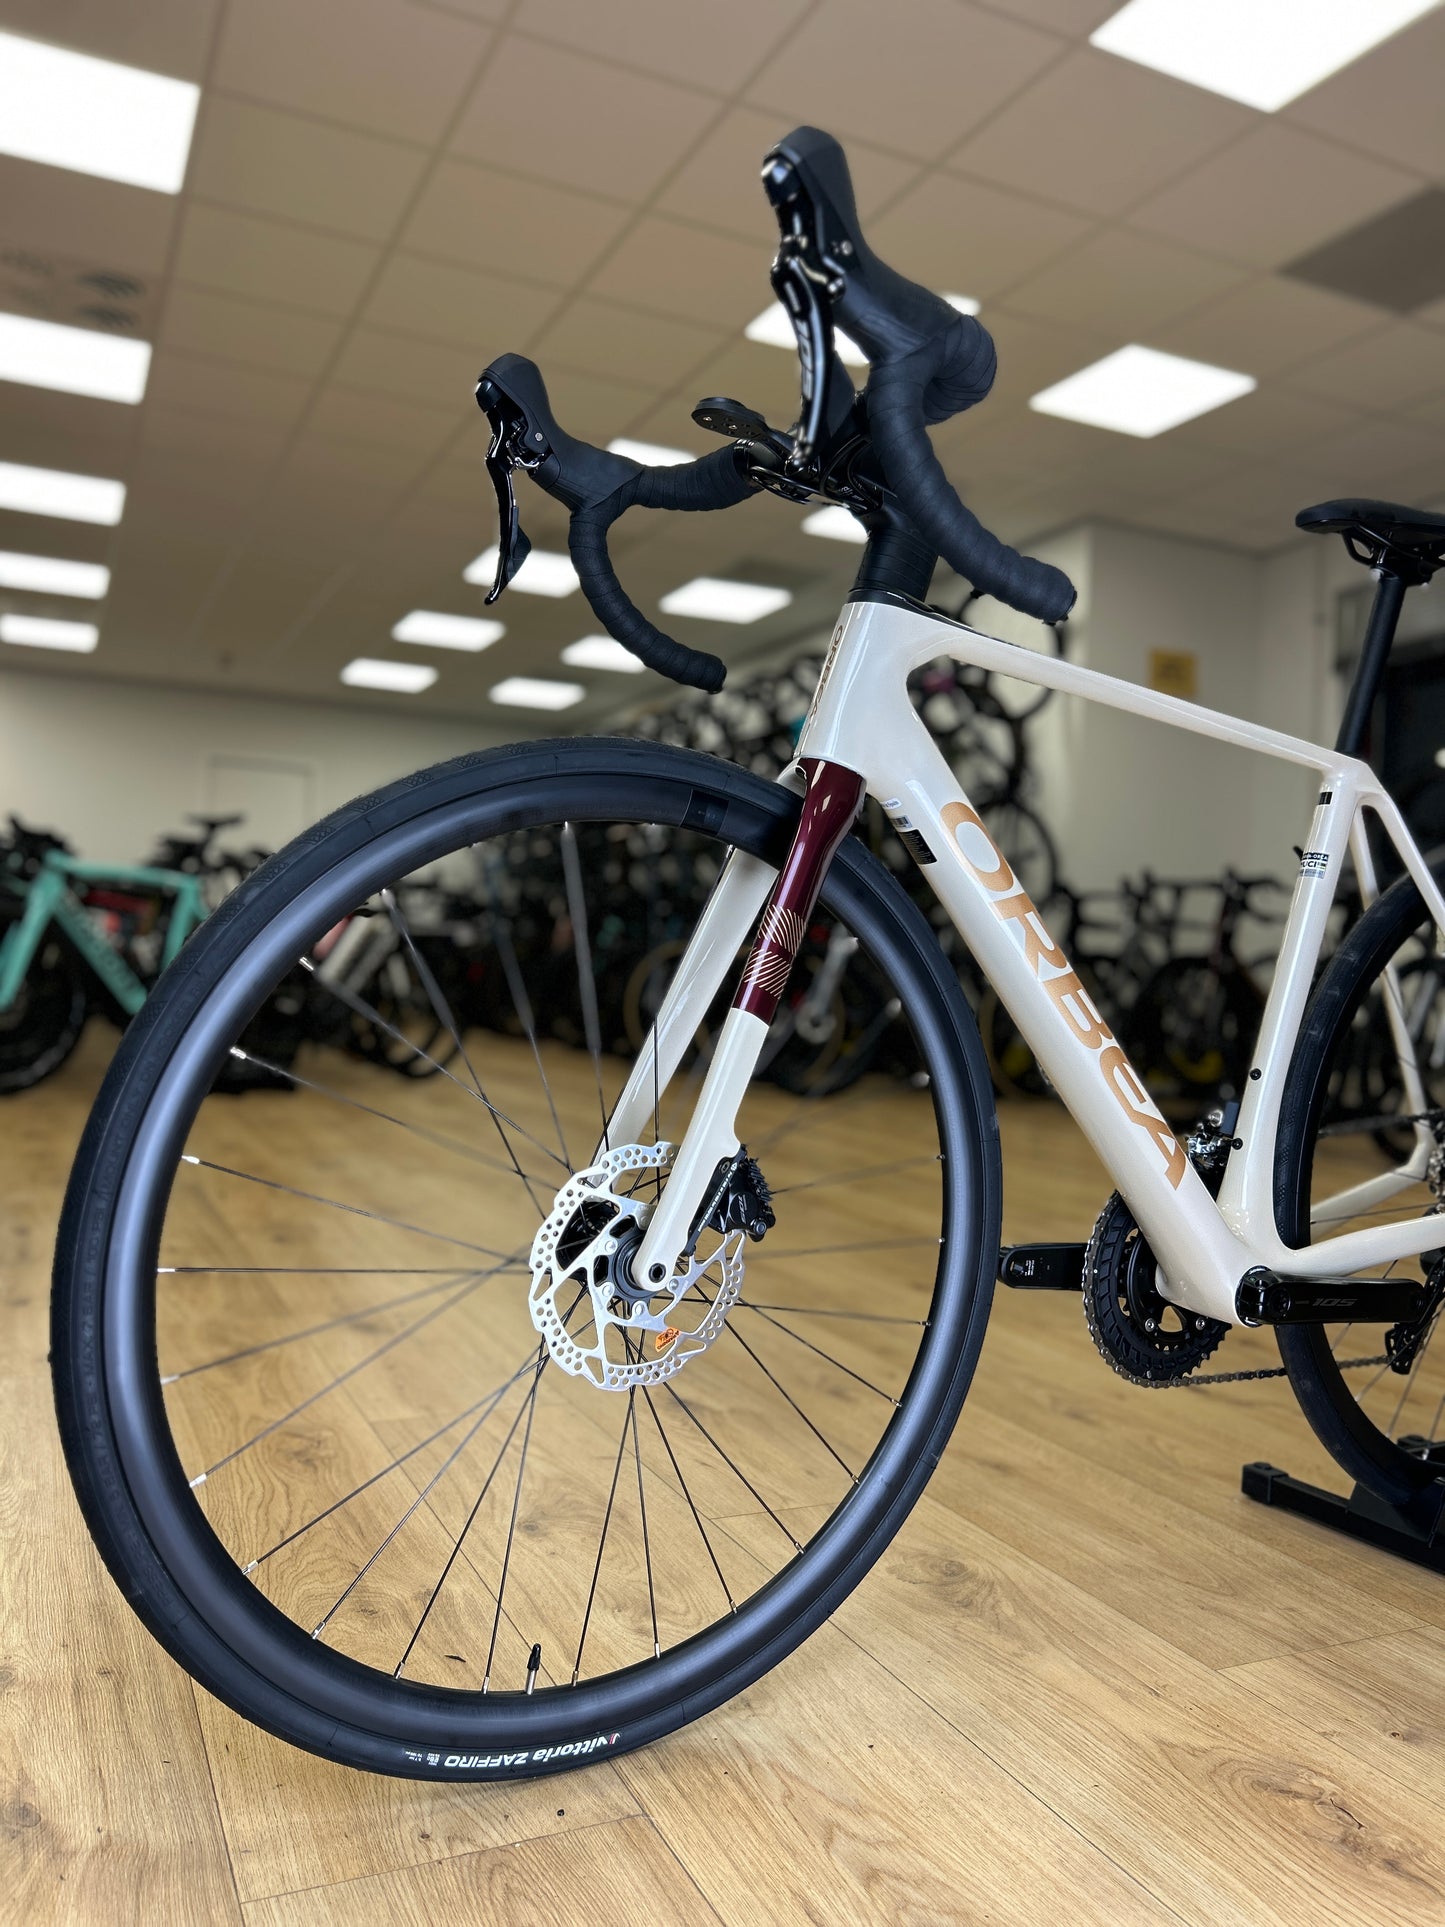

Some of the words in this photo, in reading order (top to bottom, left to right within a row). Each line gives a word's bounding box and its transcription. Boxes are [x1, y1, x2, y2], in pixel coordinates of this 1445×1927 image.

[940, 801, 1187, 1191] ORBEA
[1312, 1298, 1358, 1307] 105
[444, 1752, 527, 1768] ZAFFIRO
[532, 1735, 608, 1763] vittoria
